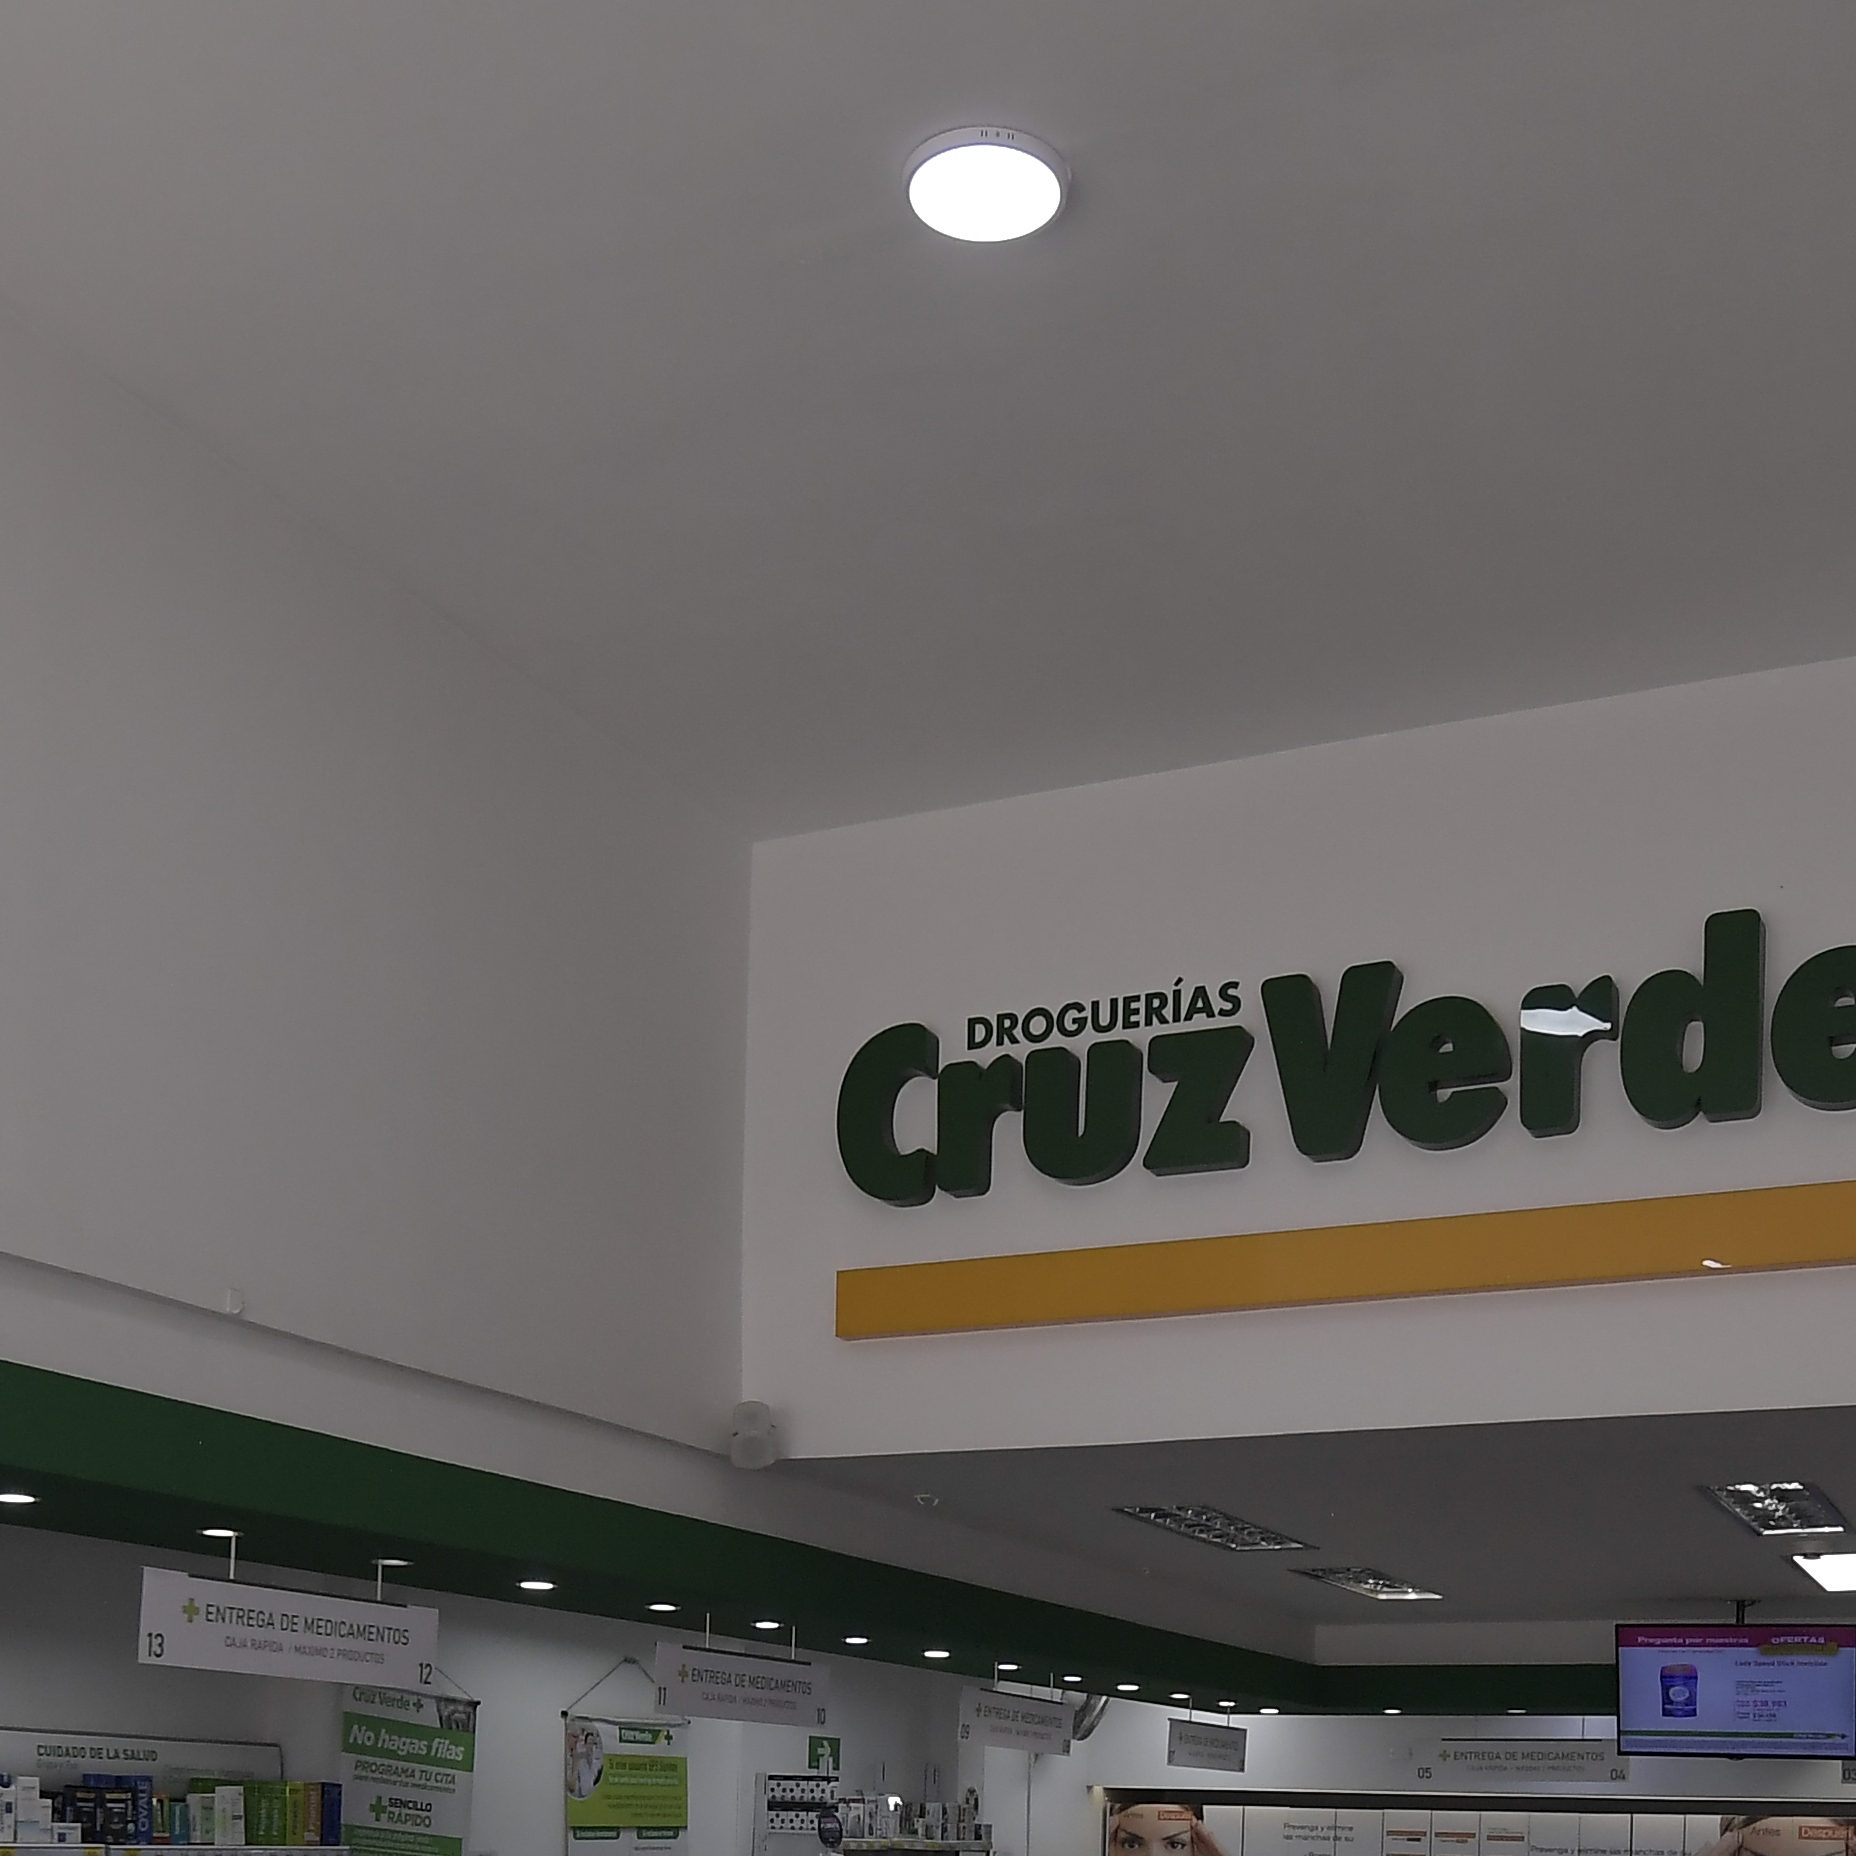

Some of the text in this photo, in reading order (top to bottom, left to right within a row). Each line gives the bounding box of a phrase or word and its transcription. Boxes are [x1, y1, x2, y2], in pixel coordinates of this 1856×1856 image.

[966, 977, 1242, 1051] DROGUERÍAS
[837, 1020, 1253, 1208] Cruz
[206, 1604, 409, 1646] ENTREGA DE MEDICAMENTOS
[147, 1633, 165, 1658] 13
[419, 1663, 432, 1684] 12
[691, 1668, 812, 1695] ENTREGA DE MEDICAMENTOS
[658, 1687, 667, 1706] 11
[817, 1708, 825, 1724] 10
[349, 1724, 464, 1761] No hagas filas
[36, 1744, 158, 1762] CUIDADO DE LA SALUD
[1454, 1751, 1604, 1762] ENTREGA DE MEDICAMENTOS
[355, 1760, 456, 1785] PROGRAMA TU CITA
[1417, 1768, 1432, 1779] 05
[1610, 1769, 1625, 1781] 04
[389, 1797, 432, 1813] SENCILLO
[1283, 1823, 1318, 1832] Prevenga
